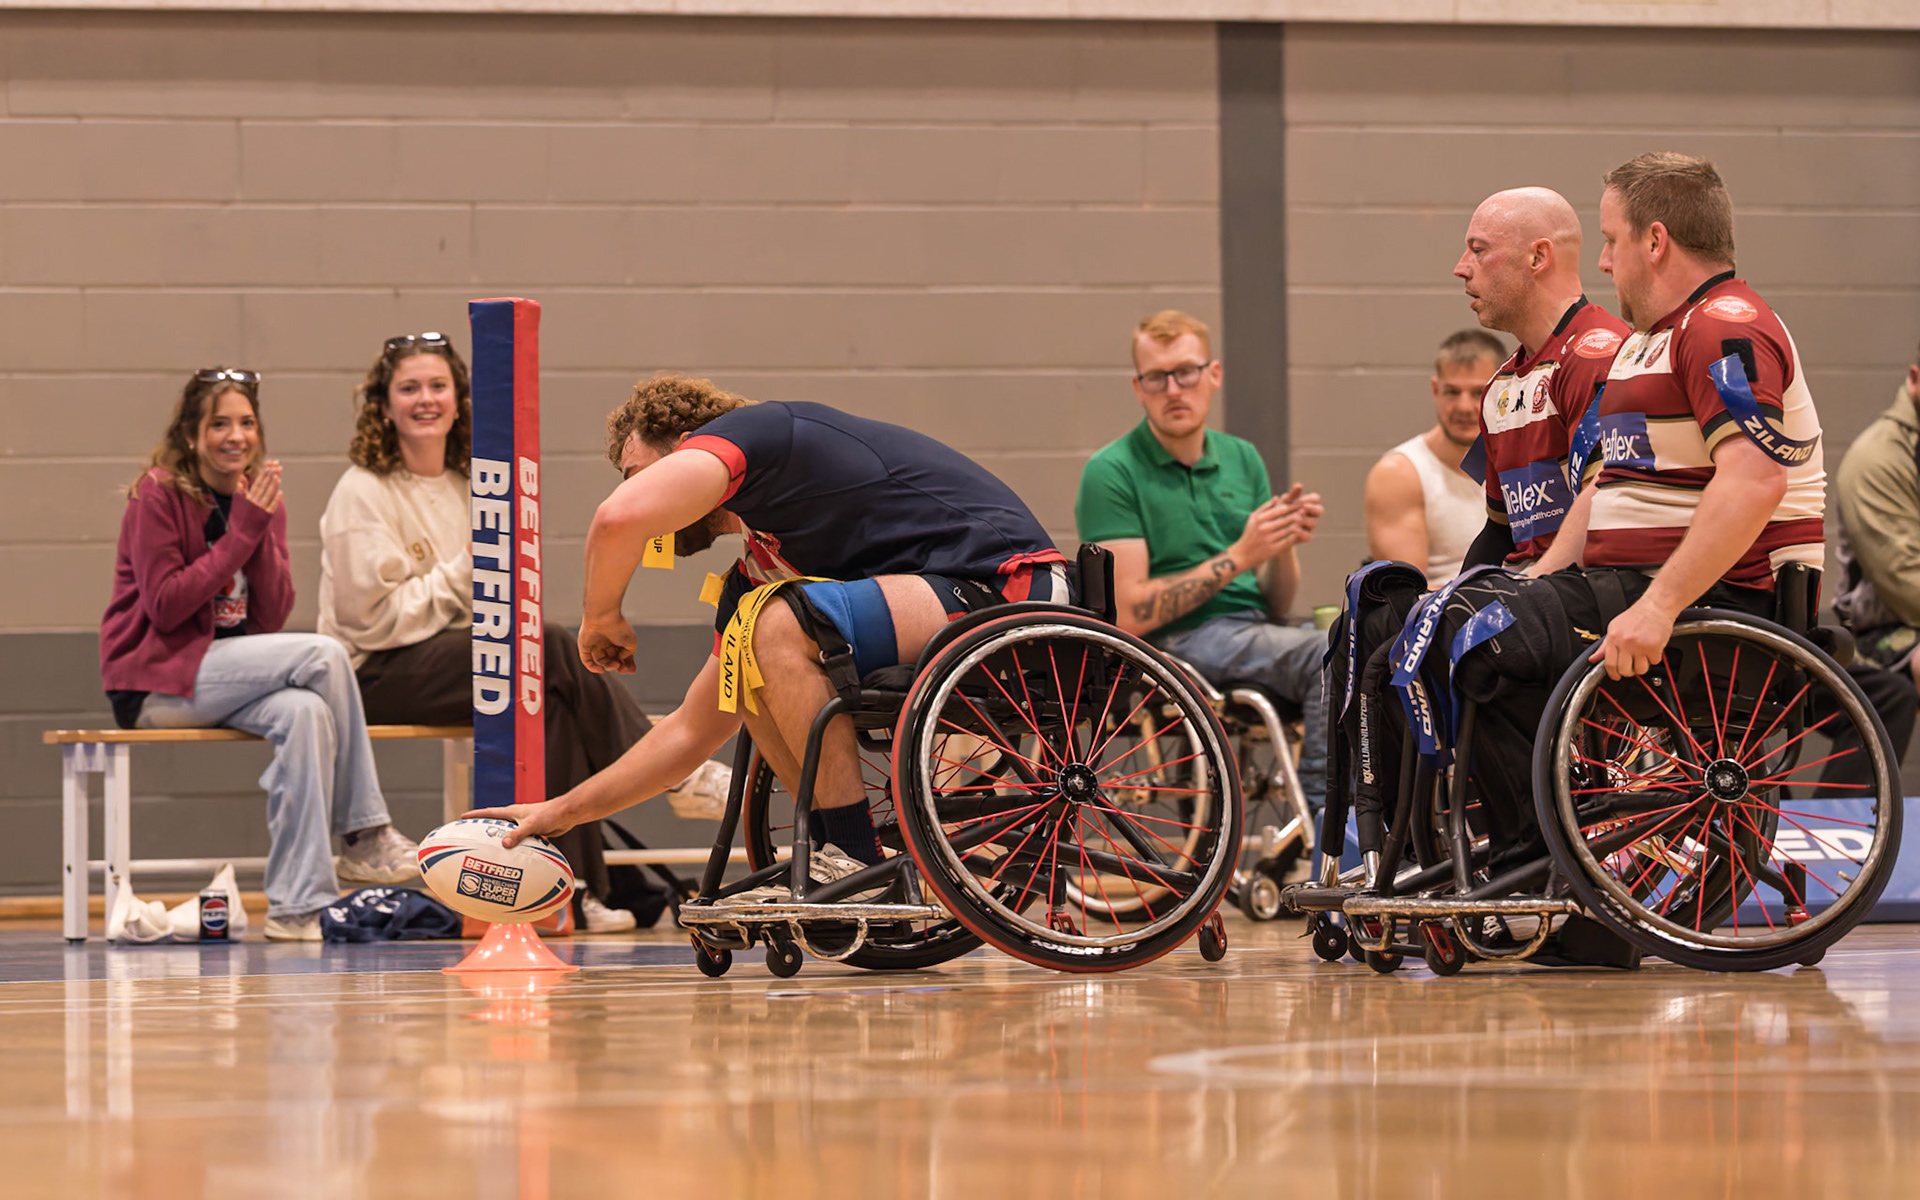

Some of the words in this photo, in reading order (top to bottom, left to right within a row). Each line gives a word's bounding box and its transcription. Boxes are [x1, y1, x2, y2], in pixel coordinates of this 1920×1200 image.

[1744, 415, 1813, 461] ZILAND
[653, 535, 663, 554] UP
[471, 457, 511, 716] BETFRED
[518, 456, 541, 715] BETFRED
[464, 858, 522, 879] BETFRED
[480, 891, 515, 905] LEAGUE
[481, 882, 517, 898] SUPER
